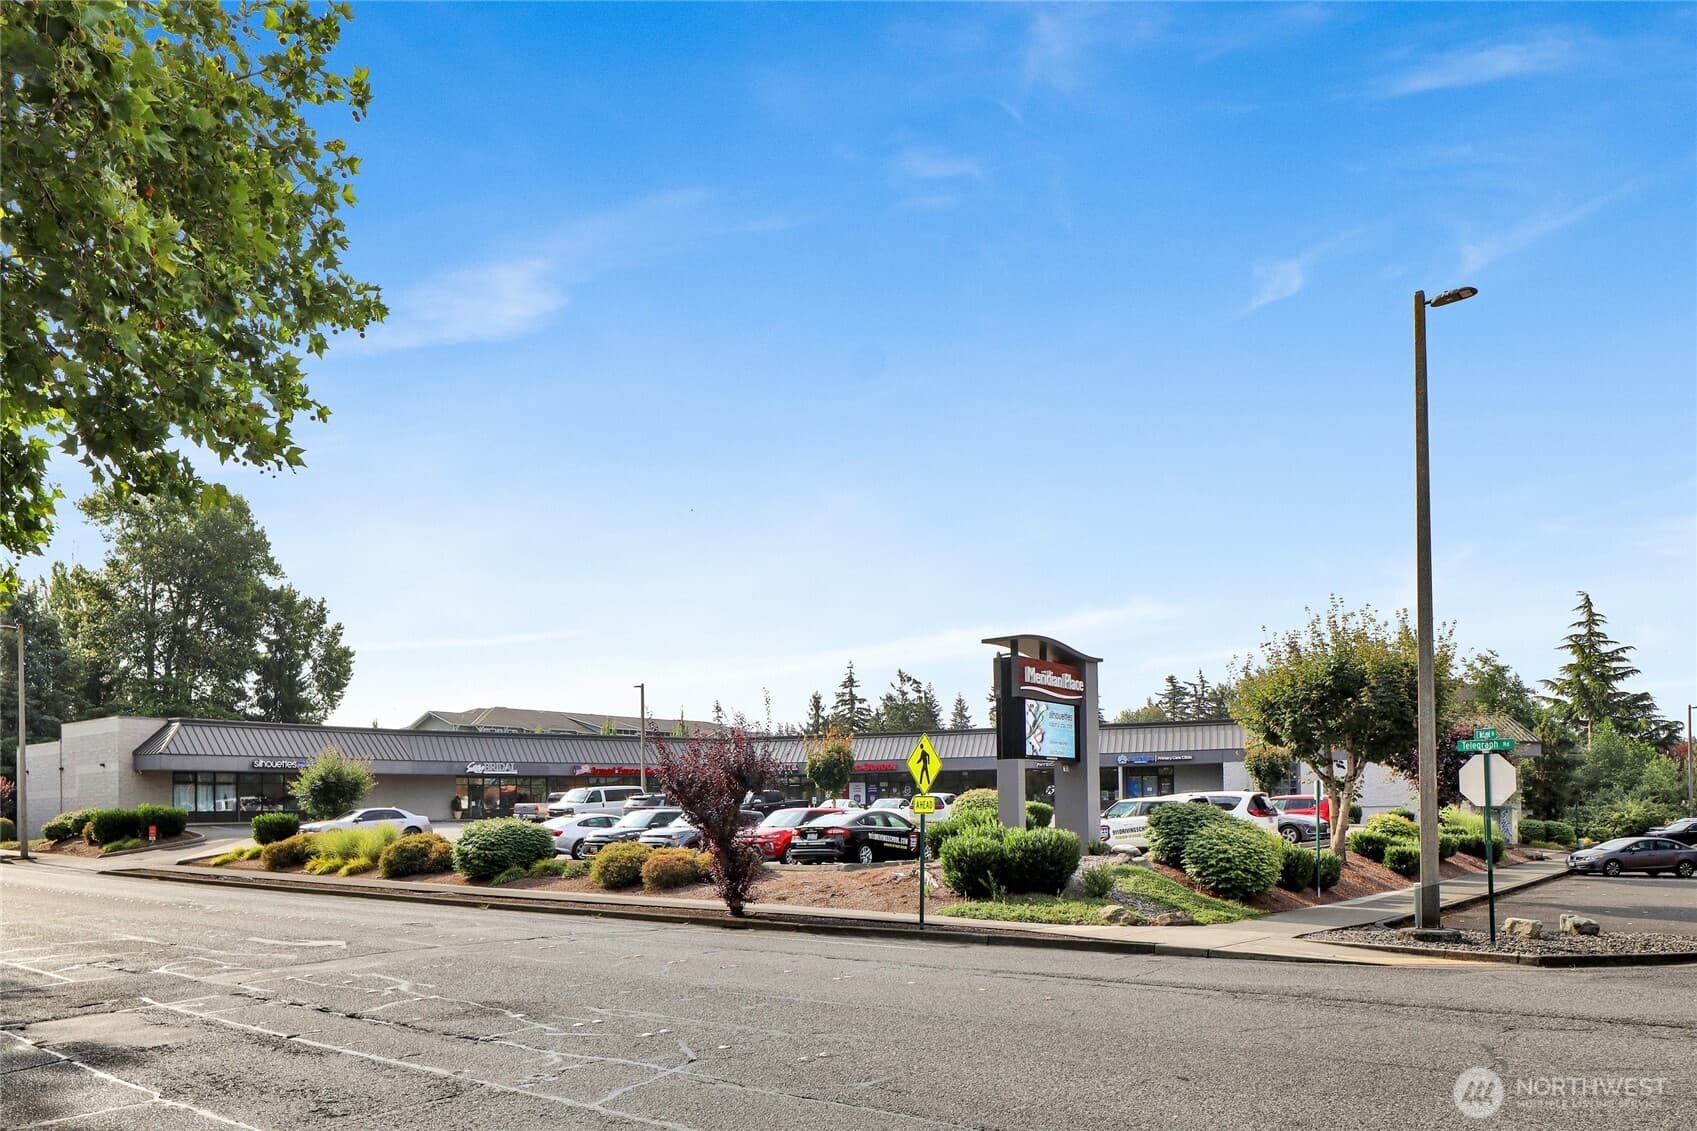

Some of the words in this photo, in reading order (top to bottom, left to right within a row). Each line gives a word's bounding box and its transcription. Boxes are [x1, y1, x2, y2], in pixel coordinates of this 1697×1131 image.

[1024, 665, 1062, 688] Meridian
[1062, 673, 1084, 692] Place
[1462, 741, 1499, 751] Telegraph
[916, 800, 933, 810] AHEAD
